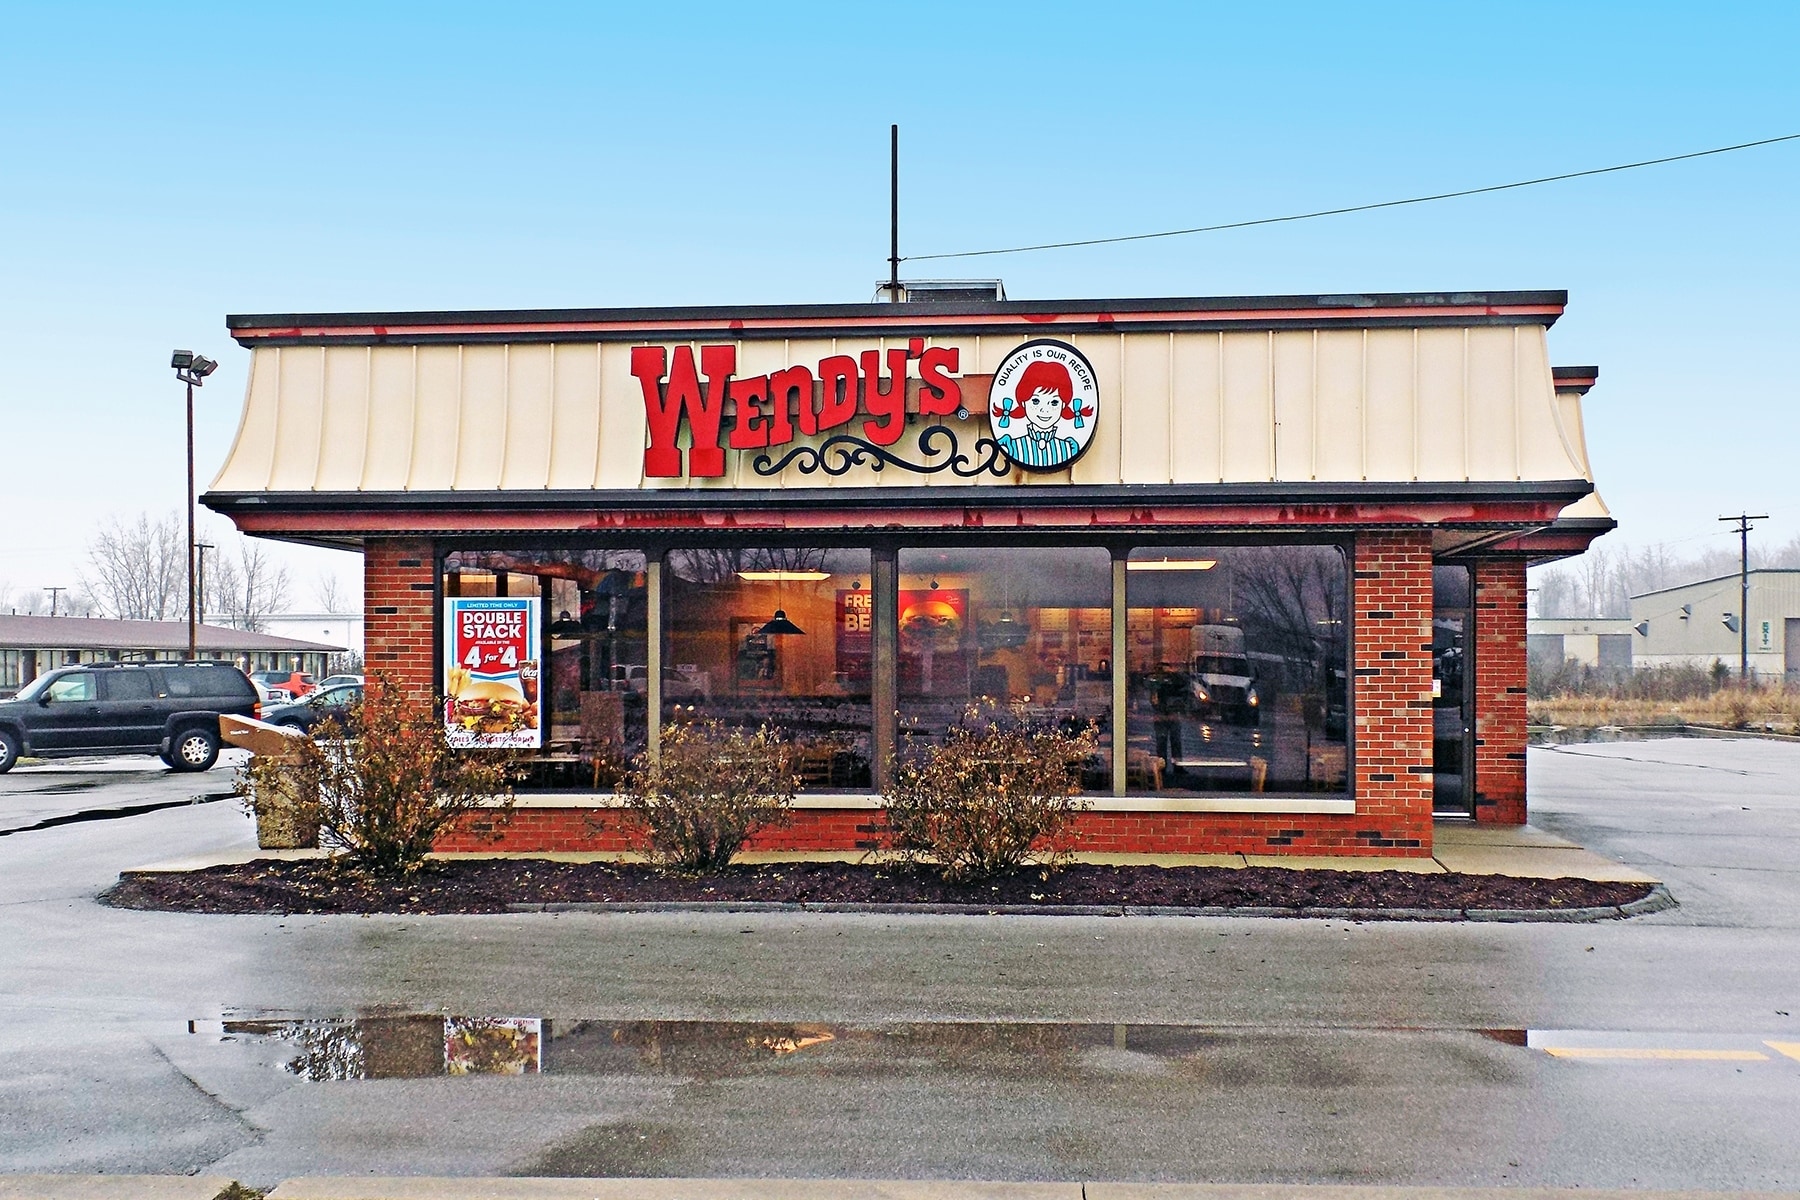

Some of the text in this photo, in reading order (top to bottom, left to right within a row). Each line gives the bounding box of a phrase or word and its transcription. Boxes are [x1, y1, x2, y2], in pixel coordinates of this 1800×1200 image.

[998, 349, 1092, 391] QUALITY IS OUR RECIPE
[631, 338, 962, 477] Wendy's
[463, 612, 522, 624] DOUBLE
[845, 613, 871, 632] BE
[463, 624, 524, 639] STACK
[464, 645, 482, 668] 4
[483, 653, 499, 664] for
